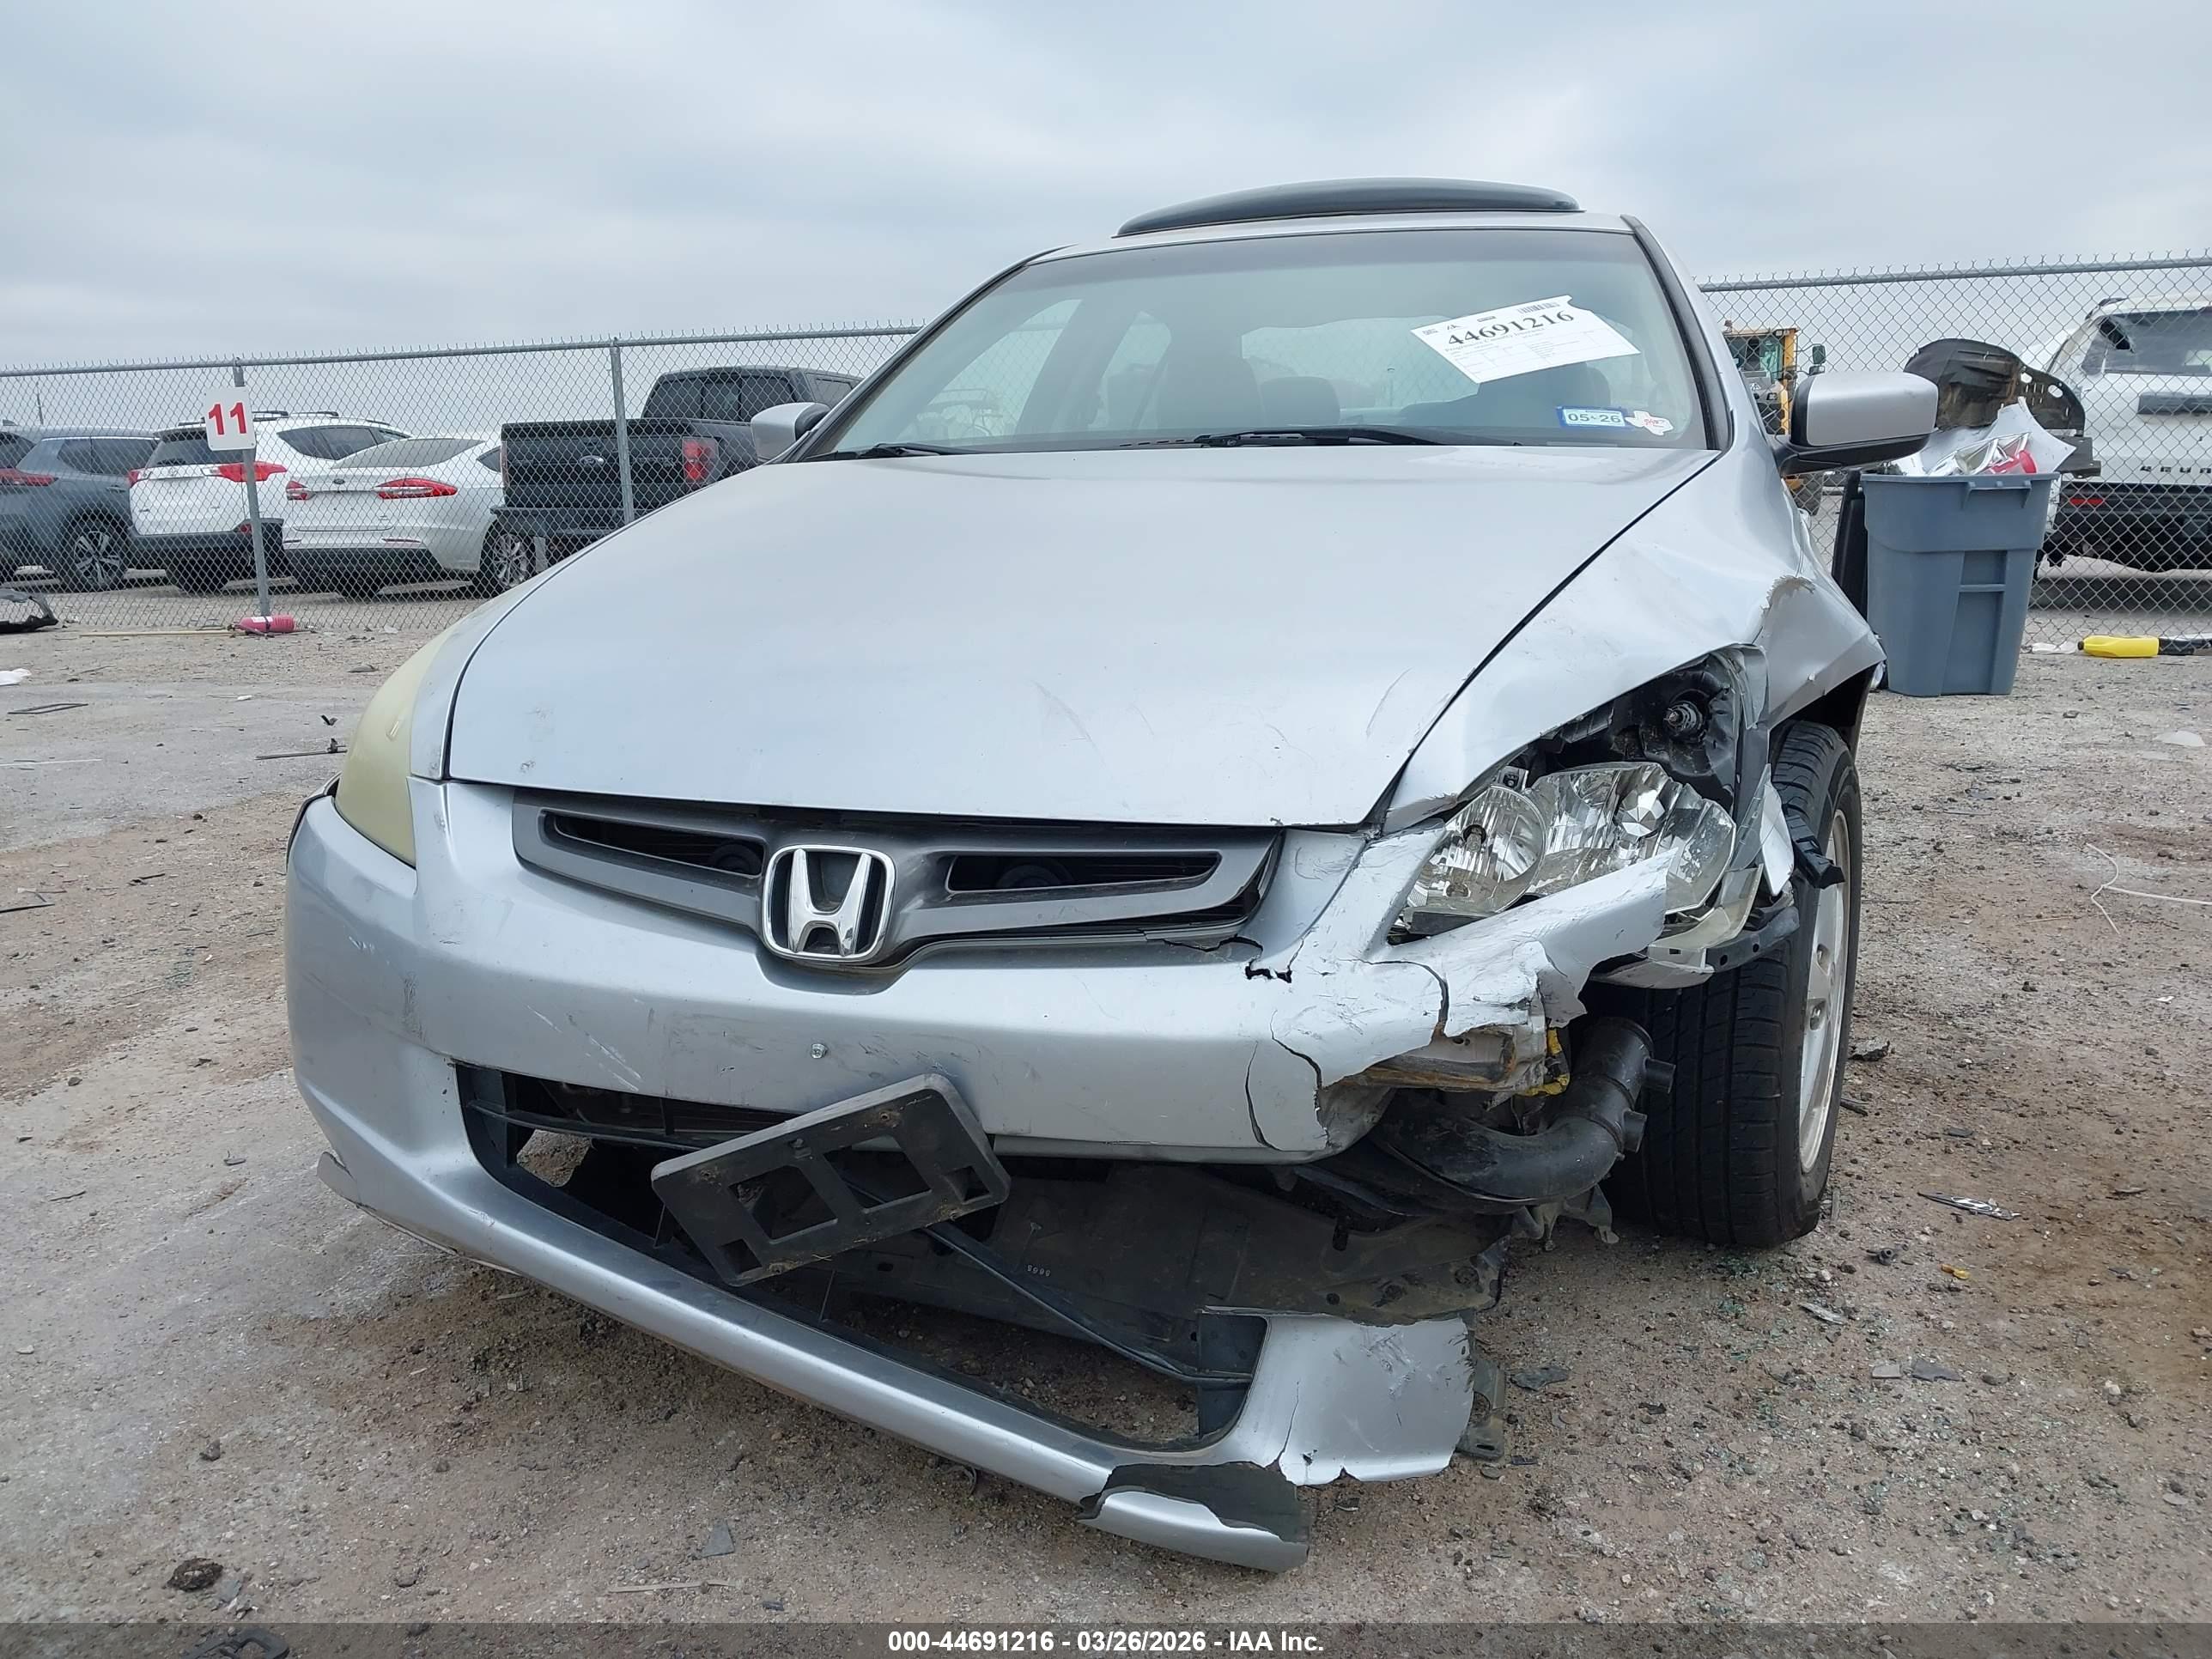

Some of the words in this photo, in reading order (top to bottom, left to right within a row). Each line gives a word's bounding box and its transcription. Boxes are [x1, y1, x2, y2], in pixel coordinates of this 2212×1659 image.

[1449, 310, 1574, 344] 44691216
[208, 402, 247, 435] 11
[1568, 413, 1590, 422] 05
[1599, 414, 1621, 423] 26
